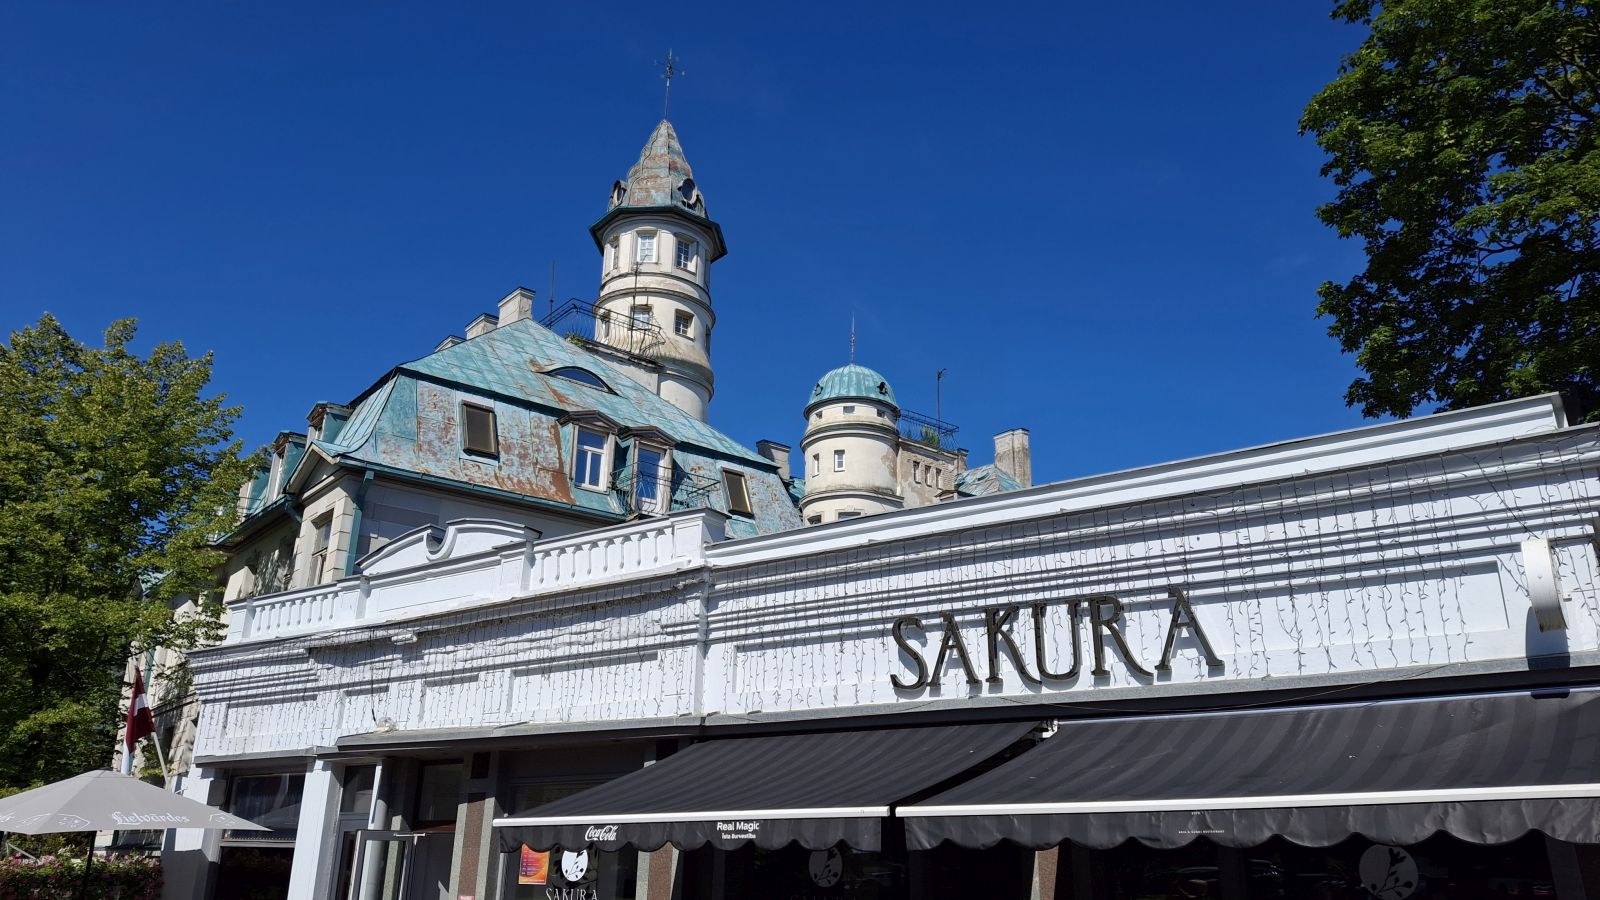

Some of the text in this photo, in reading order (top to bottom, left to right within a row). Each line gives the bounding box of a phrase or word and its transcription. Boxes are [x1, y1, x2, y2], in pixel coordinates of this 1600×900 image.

[890, 584, 1226, 690] SAKURA
[111, 811, 191, 826] Lielvārdes
[717, 821, 760, 832] Real Magic
[545, 887, 599, 900] SAKURA
